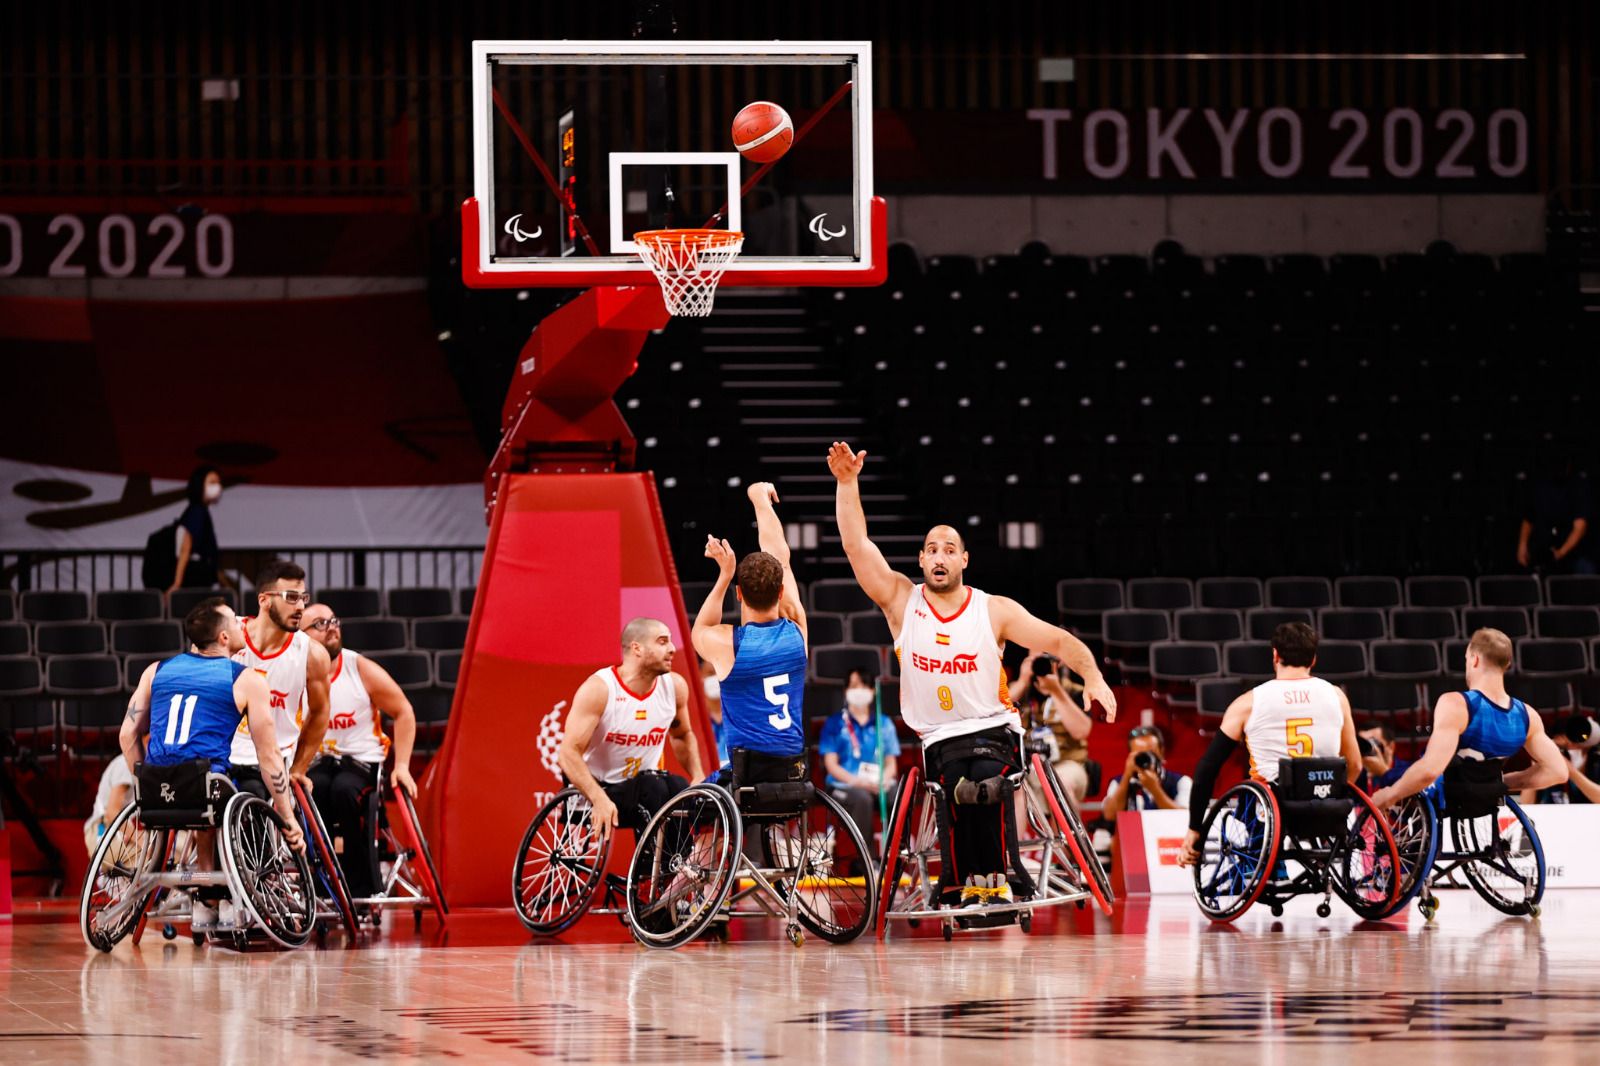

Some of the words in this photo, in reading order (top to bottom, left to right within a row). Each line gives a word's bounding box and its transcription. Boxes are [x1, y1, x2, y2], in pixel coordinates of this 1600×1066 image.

[1027, 108, 1303, 180] TOKYO
[1328, 108, 1529, 179] 2020
[48, 213, 234, 277] 2020
[912, 652, 979, 674] ESPAÑA
[763, 674, 792, 730] 5
[937, 686, 953, 711] 9
[1283, 690, 1311, 704] STIX
[164, 694, 198, 744] 11
[1285, 718, 1314, 758] 5
[1307, 770, 1334, 781] STIX
